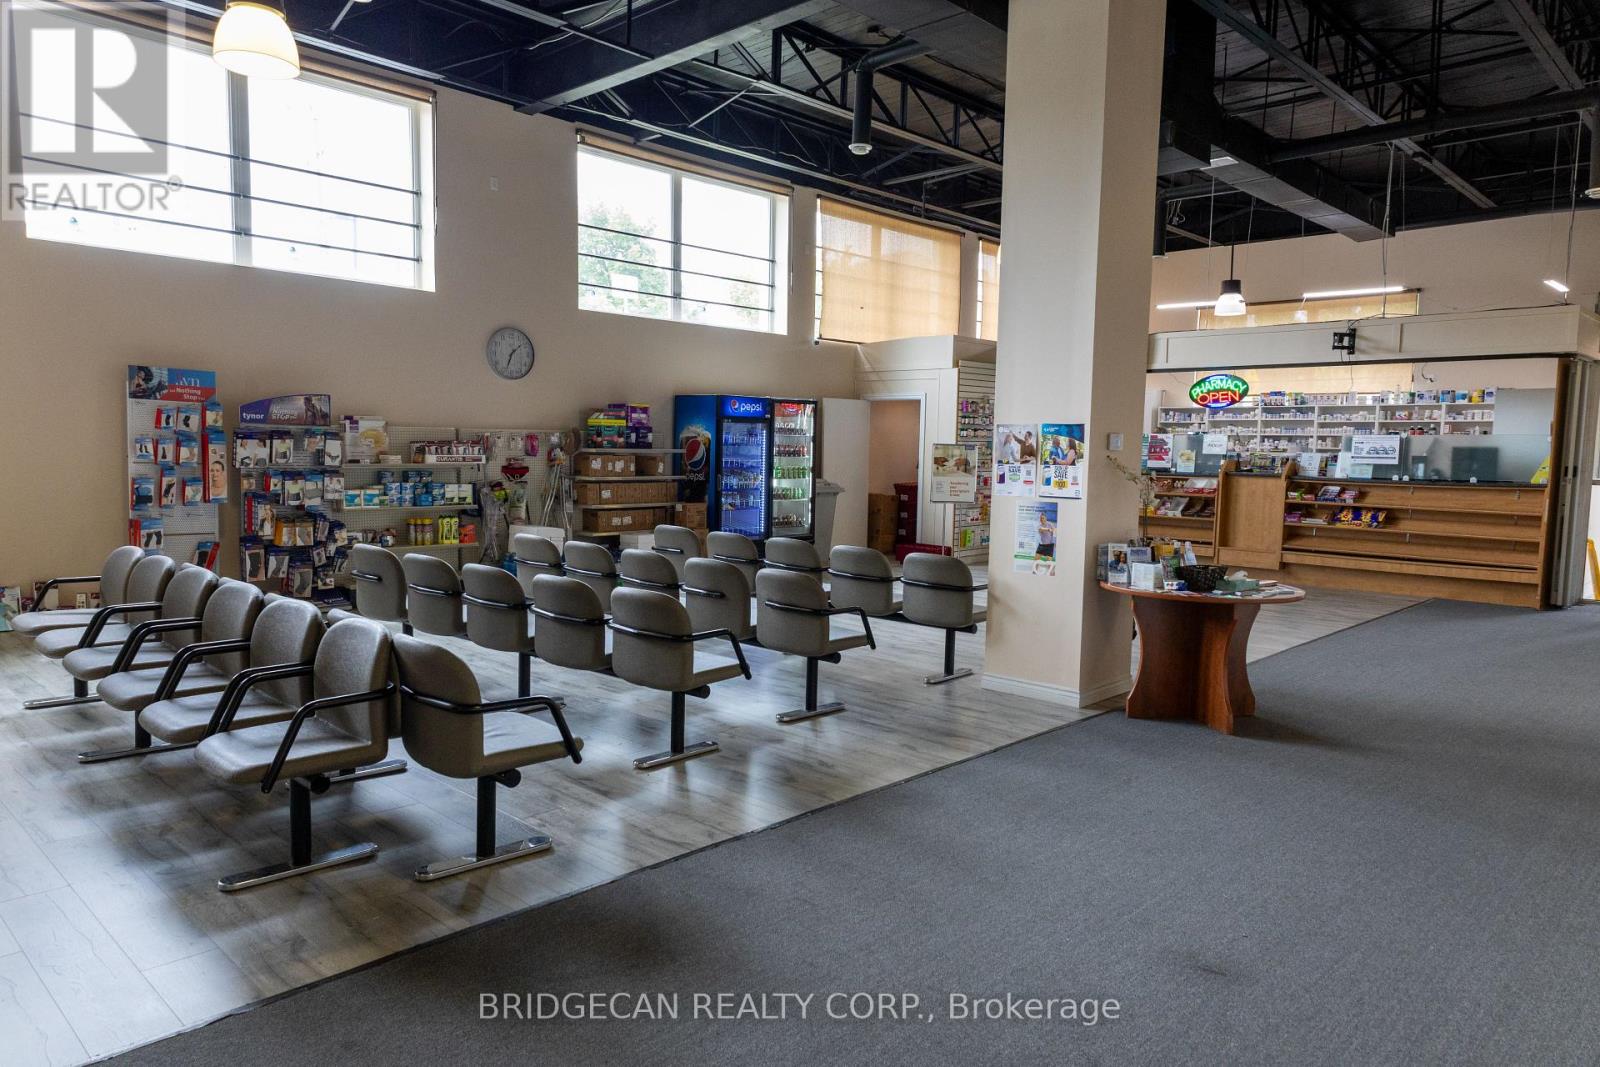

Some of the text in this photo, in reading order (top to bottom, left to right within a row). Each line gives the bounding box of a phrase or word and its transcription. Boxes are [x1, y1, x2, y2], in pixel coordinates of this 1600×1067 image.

[1190, 379, 1248, 400] PHARMACY
[1197, 390, 1241, 405] OPEN
[740, 402, 763, 414] pepsi
[242, 412, 265, 420] tynor
[1053, 470, 1069, 479] SAVE
